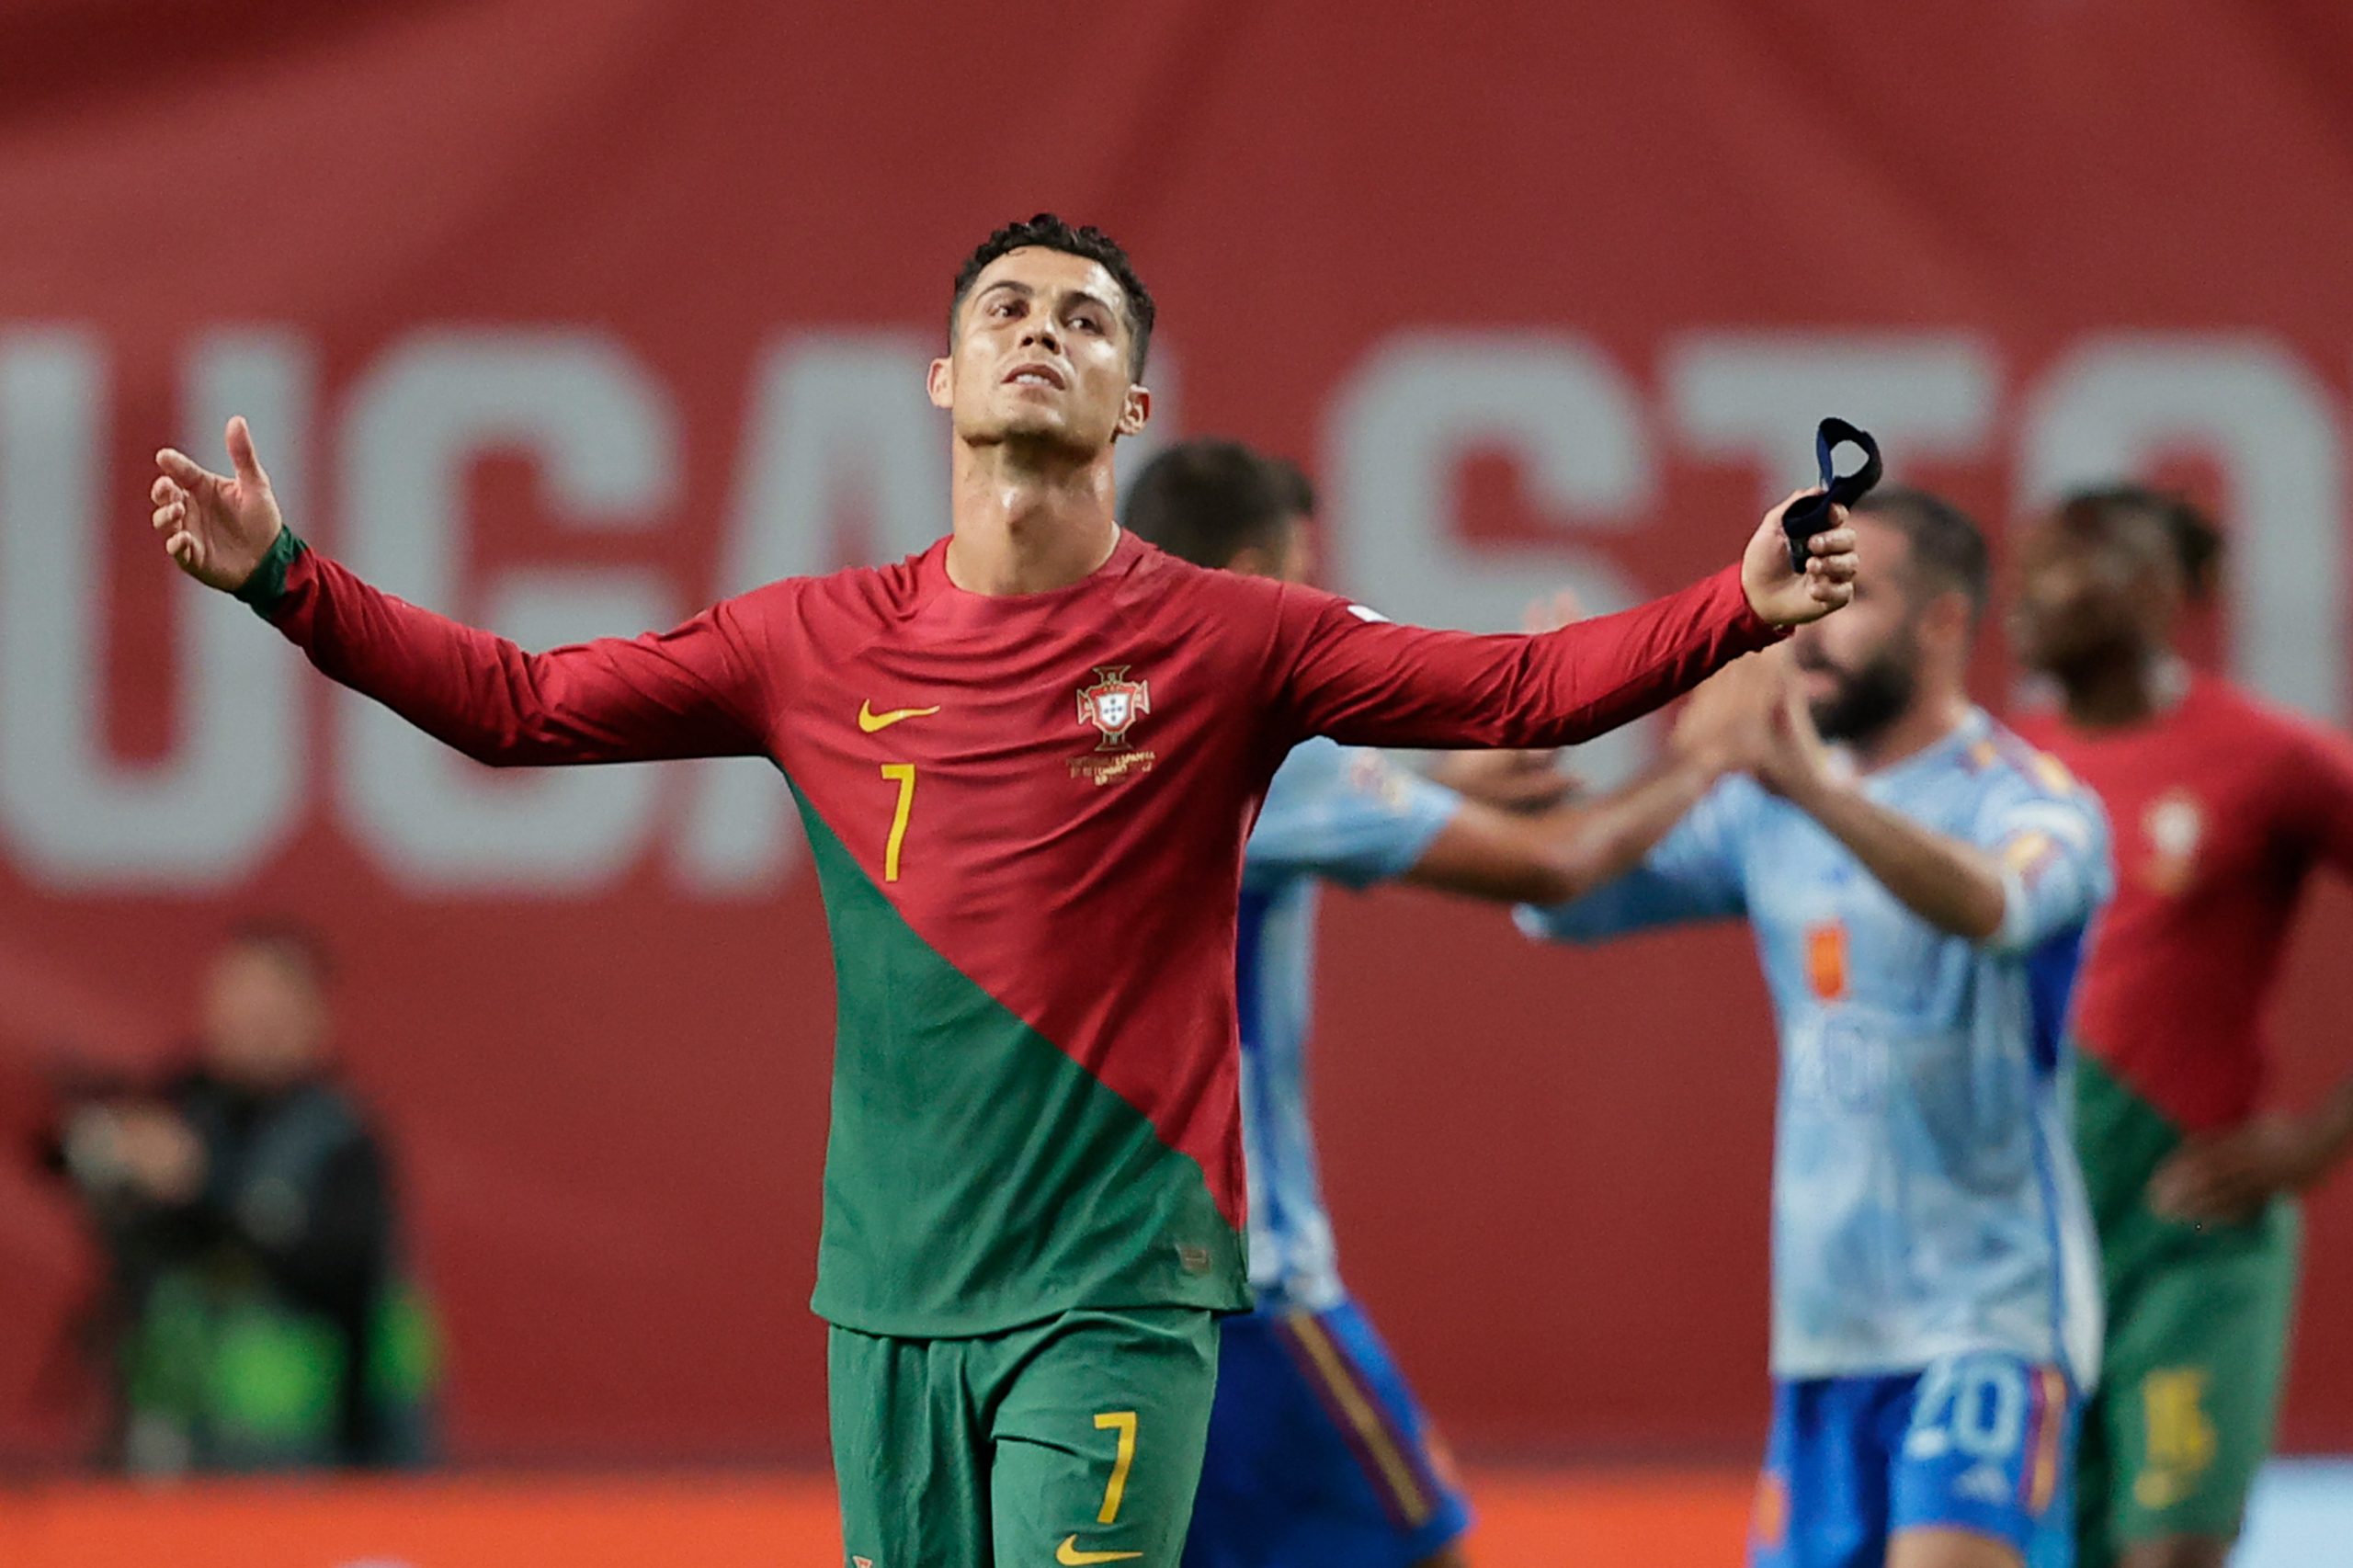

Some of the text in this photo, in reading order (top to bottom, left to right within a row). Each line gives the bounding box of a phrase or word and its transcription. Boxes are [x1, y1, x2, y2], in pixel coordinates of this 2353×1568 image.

[880, 763, 915, 882] 7
[1902, 1355, 2026, 1460] 20
[1093, 1411, 1137, 1525] 7
